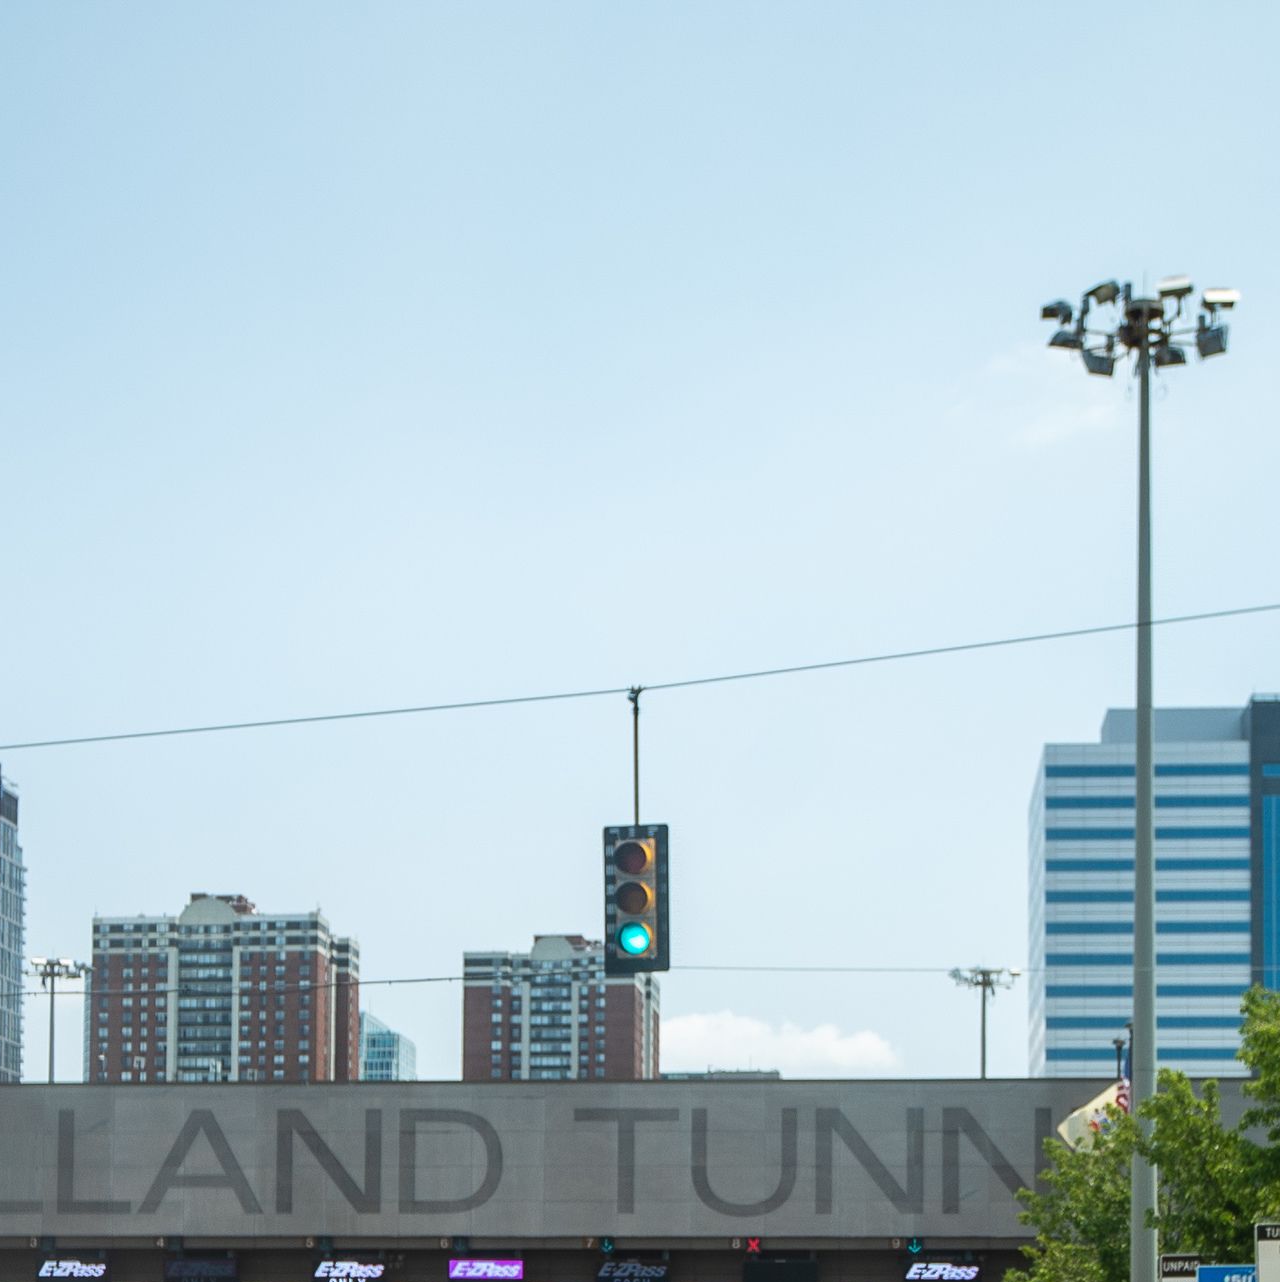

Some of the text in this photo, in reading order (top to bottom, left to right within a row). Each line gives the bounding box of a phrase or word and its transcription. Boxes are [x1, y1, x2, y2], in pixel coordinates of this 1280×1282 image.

[30, 1237, 37, 1248] 3
[156, 1237, 164, 1248] 4
[440, 1238, 448, 1248] 6
[586, 1238, 594, 1248] 7
[732, 1238, 741, 1248] 8
[892, 1238, 900, 1249] 9
